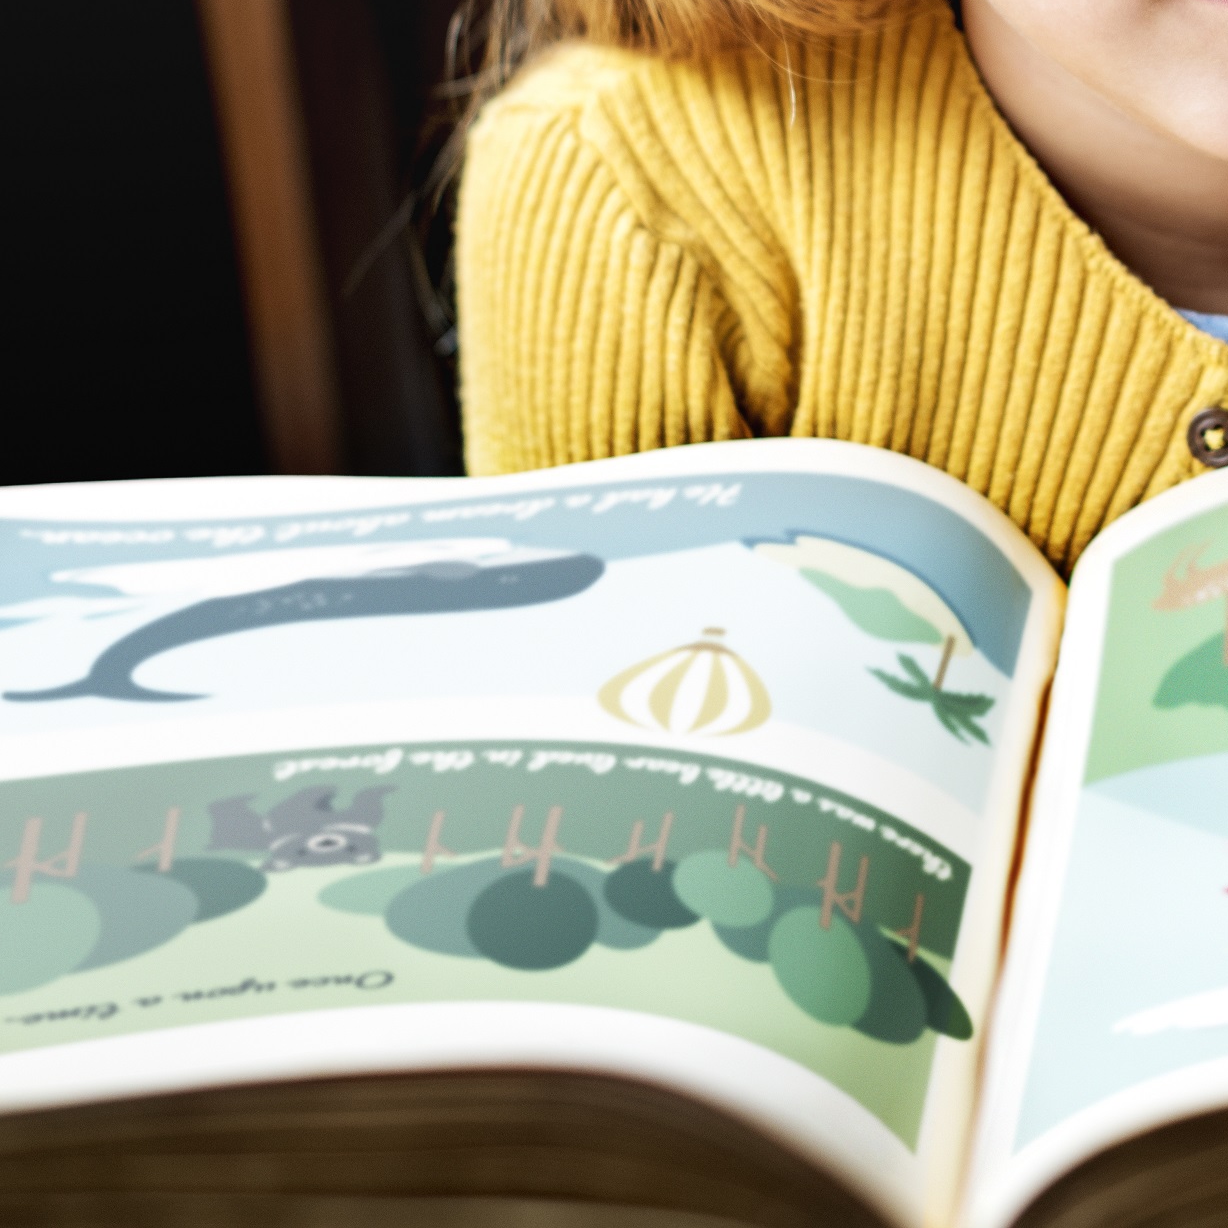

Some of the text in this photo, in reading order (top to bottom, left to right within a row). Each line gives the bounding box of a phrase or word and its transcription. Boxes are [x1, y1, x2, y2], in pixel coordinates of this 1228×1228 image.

[563, 493, 592, 509] a
[591, 489, 678, 512] had
[683, 483, 742, 507] He
[423, 497, 556, 521] dream
[184, 526, 264, 548] the
[273, 511, 412, 543] about
[273, 747, 952, 880] there was a little bear lived in the forest
[172, 977, 278, 1002] upon
[286, 969, 394, 991] Once
[132, 994, 163, 1009] a
